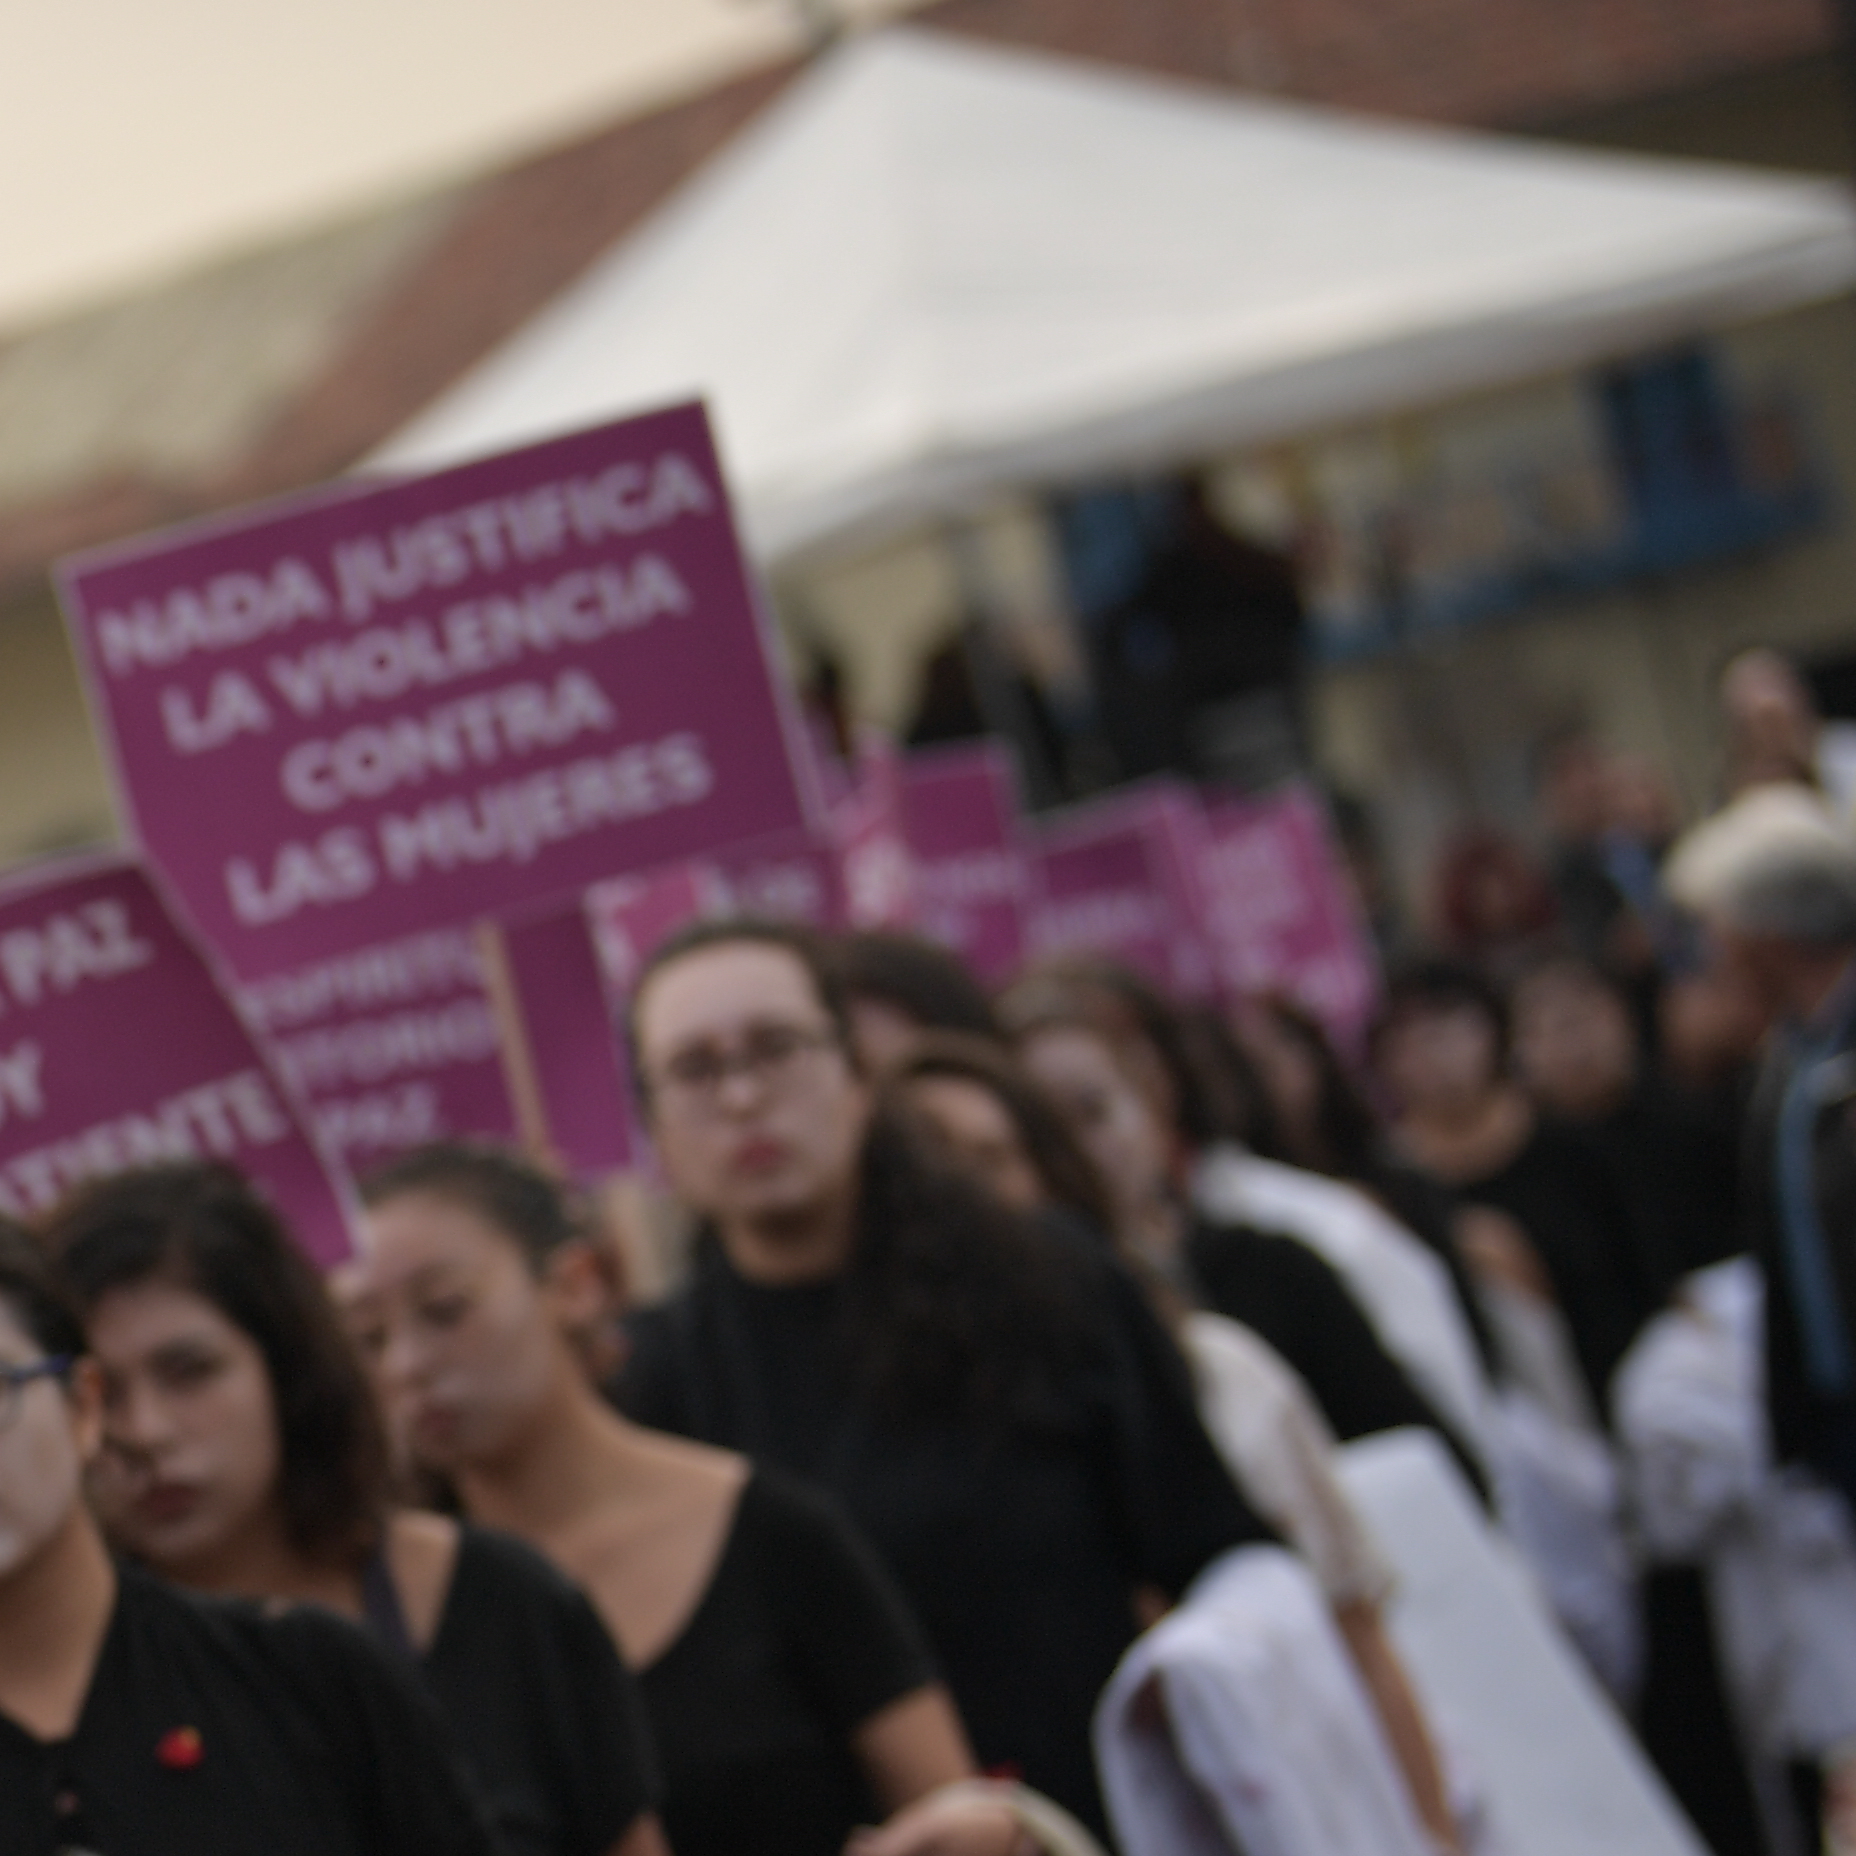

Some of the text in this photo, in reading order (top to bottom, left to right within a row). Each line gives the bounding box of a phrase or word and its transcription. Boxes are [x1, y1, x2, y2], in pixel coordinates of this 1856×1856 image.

[97, 452, 710, 677] NADA JUSTIFICA
[158, 554, 688, 754] LA VIOLENCIA
[224, 732, 714, 926] LAS MUJERES
[283, 668, 615, 812] CONTRA
